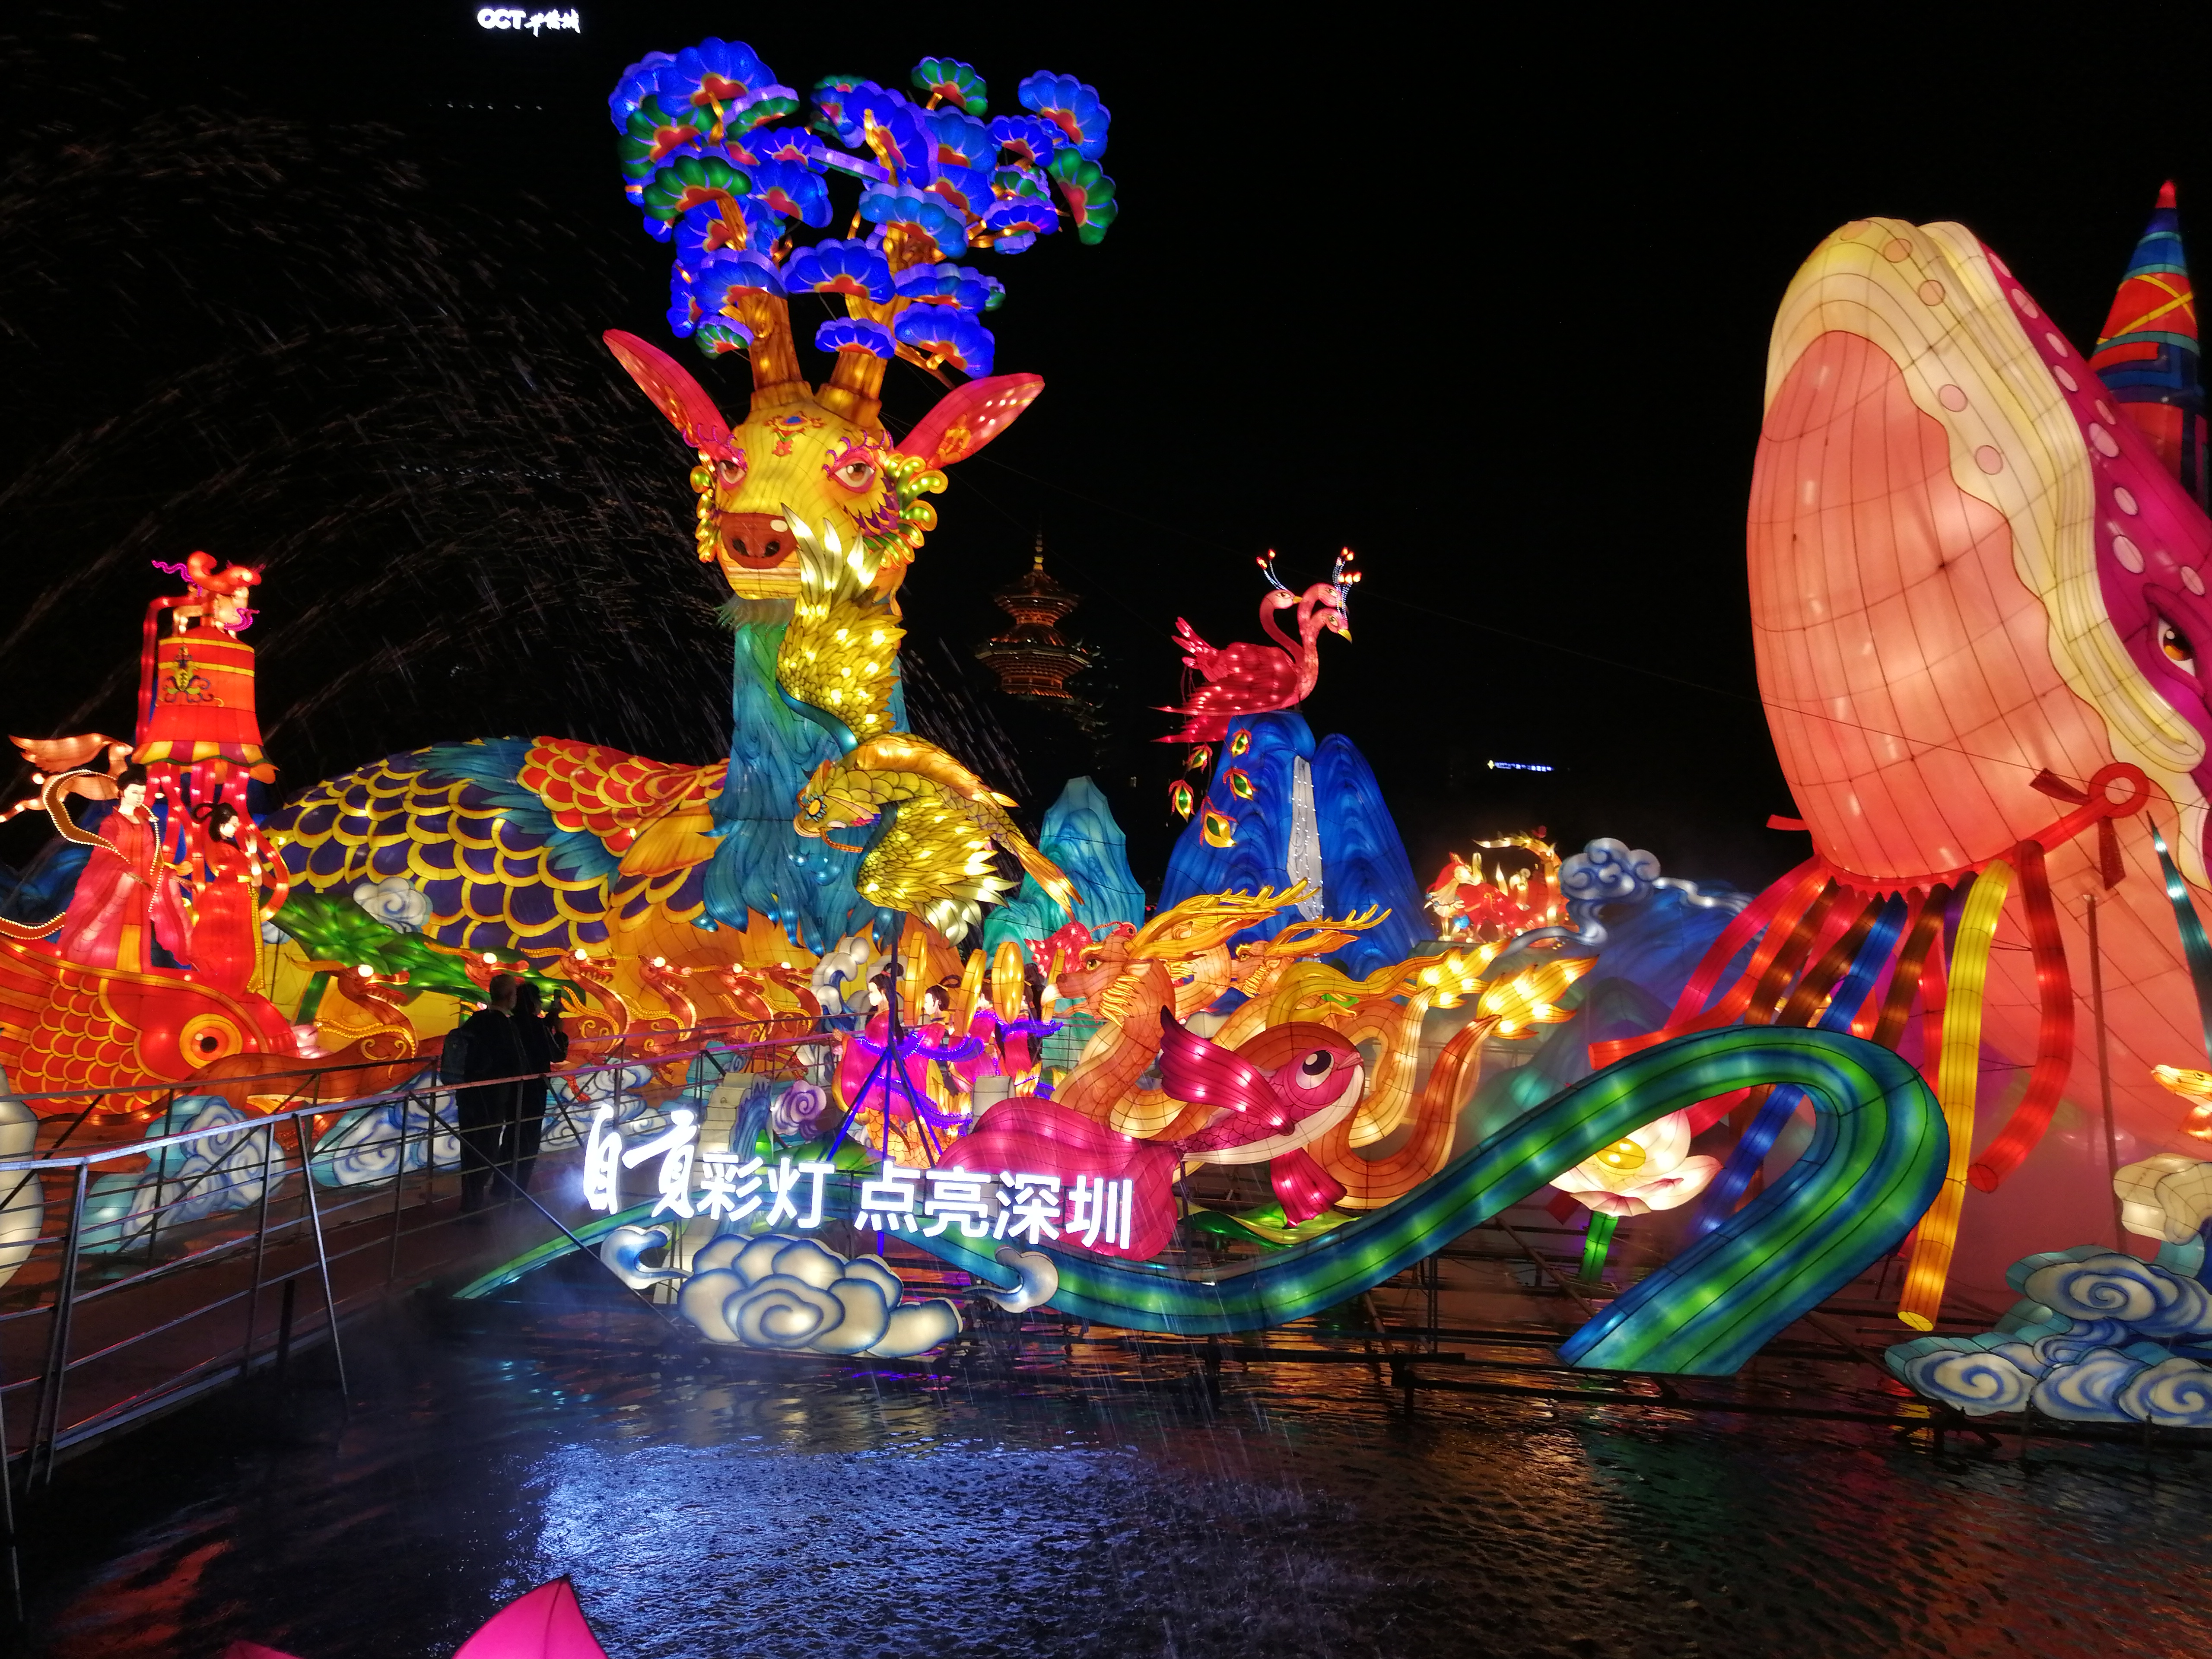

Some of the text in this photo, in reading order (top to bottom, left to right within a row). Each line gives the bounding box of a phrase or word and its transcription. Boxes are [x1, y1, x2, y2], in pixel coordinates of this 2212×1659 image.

[477, 8, 527, 30] OCT
[582, 1102, 1133, 1250] 自贡彩灯 点亮深圳
